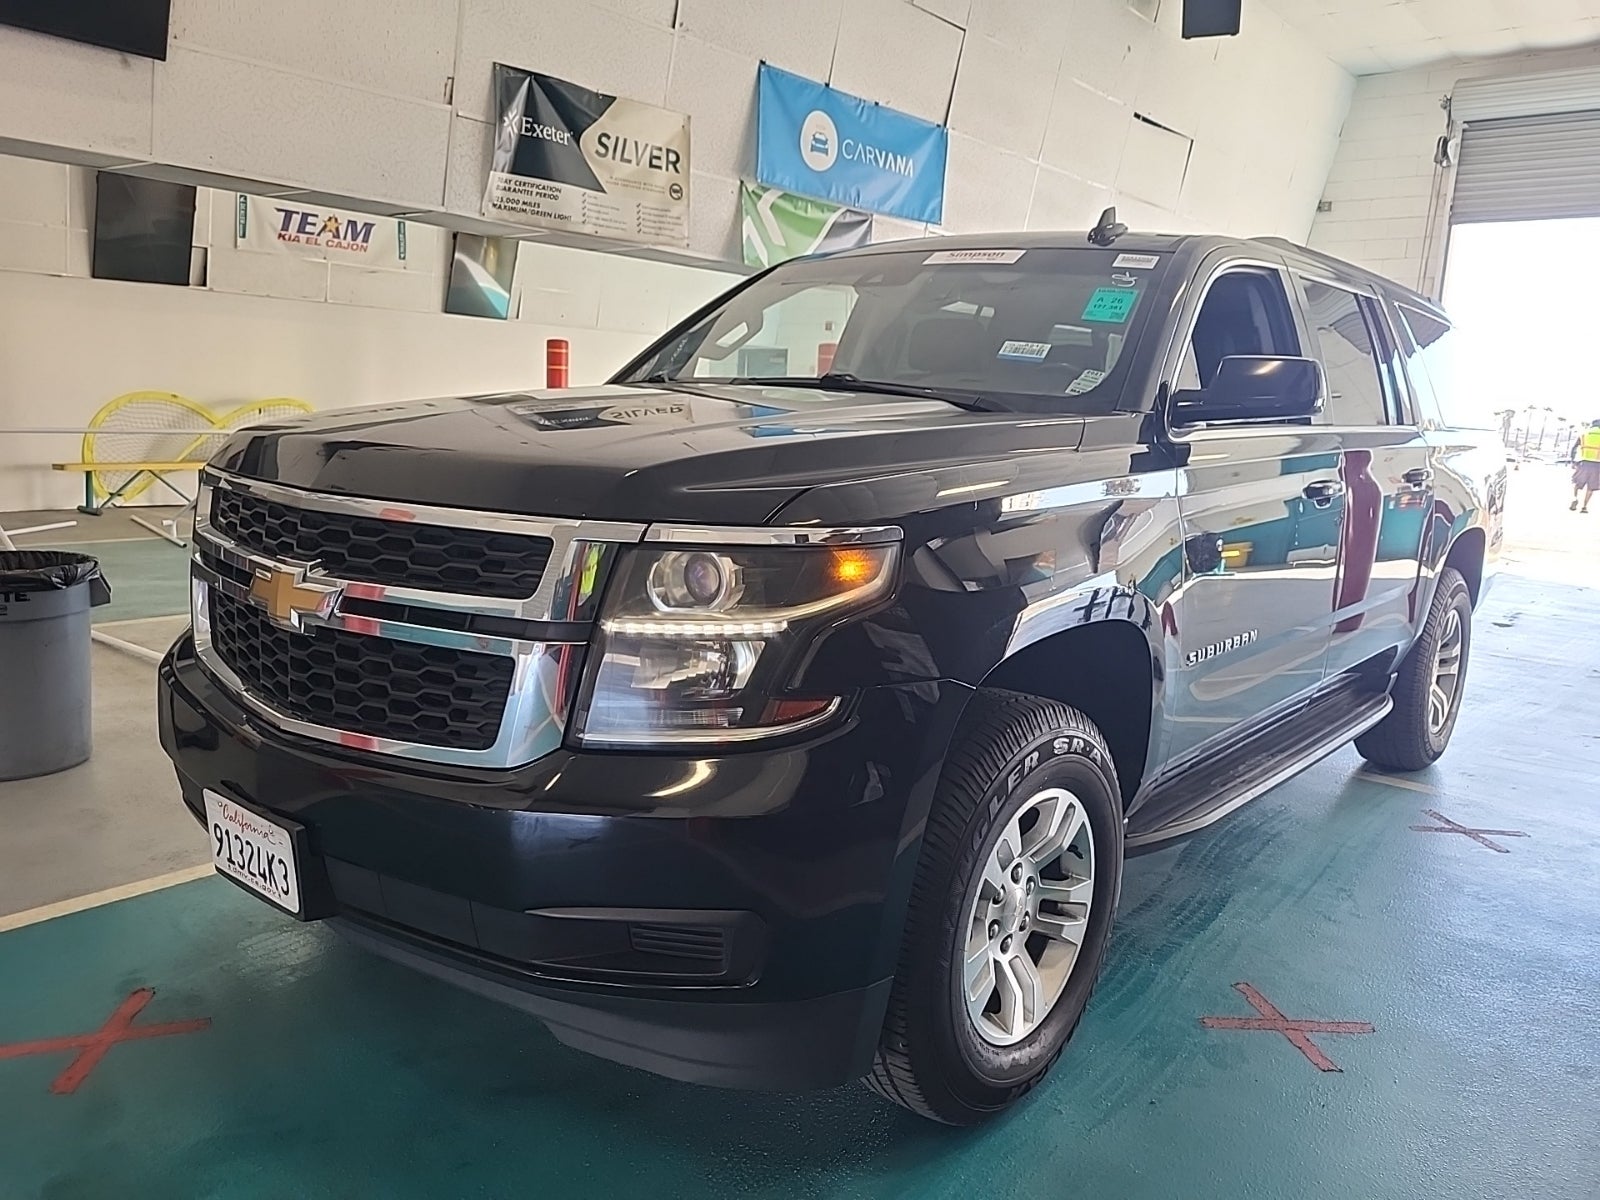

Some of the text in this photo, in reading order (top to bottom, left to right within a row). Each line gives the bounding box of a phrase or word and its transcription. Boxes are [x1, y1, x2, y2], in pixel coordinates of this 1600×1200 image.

[521, 116, 571, 146] Exeter
[595, 132, 681, 174] SILVER
[842, 139, 914, 178] CARVANA
[514, 180, 562, 194] CERTIFICATION
[535, 191, 560, 201] PERIOD
[522, 199, 541, 209] MILES
[554, 212, 572, 222] LIGHT
[274, 207, 376, 243] TEAM
[277, 232, 369, 253] KIA EL CAJON
[1186, 629, 1258, 667] SUBURBAN
[222, 803, 276, 846] California
